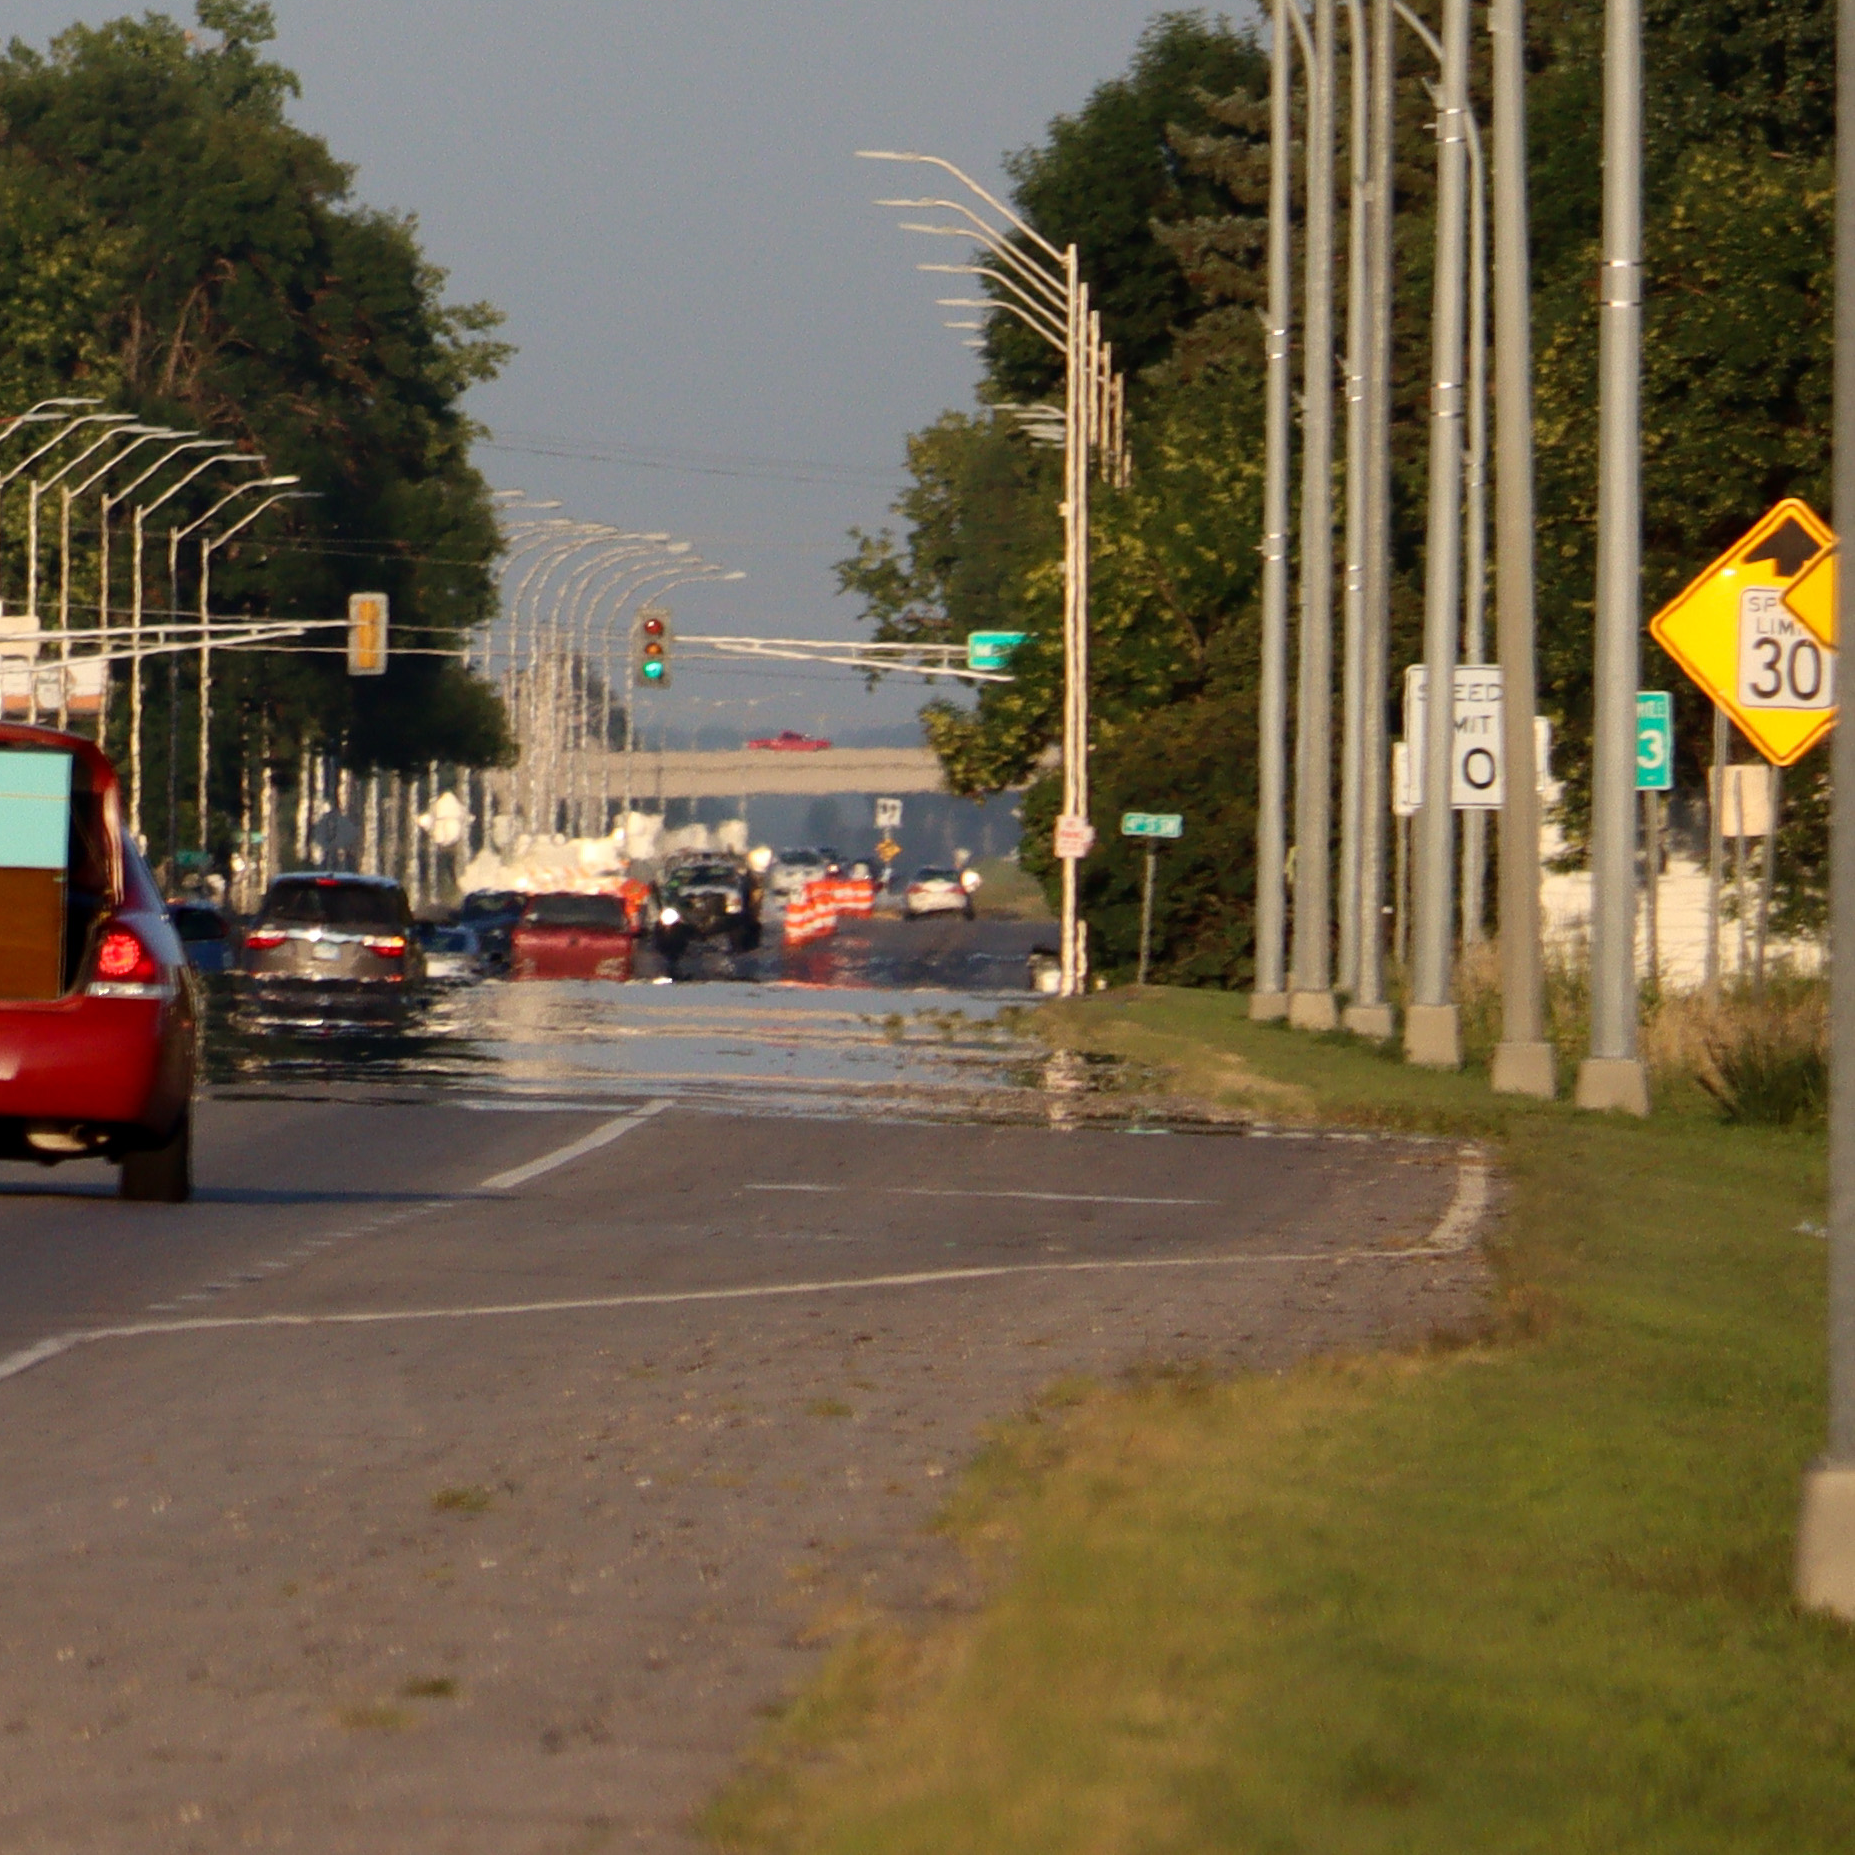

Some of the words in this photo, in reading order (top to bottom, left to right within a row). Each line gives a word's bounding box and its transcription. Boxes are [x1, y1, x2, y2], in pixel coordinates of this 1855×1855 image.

[1756, 617, 1802, 636] LIM
[1749, 636, 1822, 702] 30
[1417, 683, 1504, 703] SEED
[1636, 729, 1664, 769] 3
